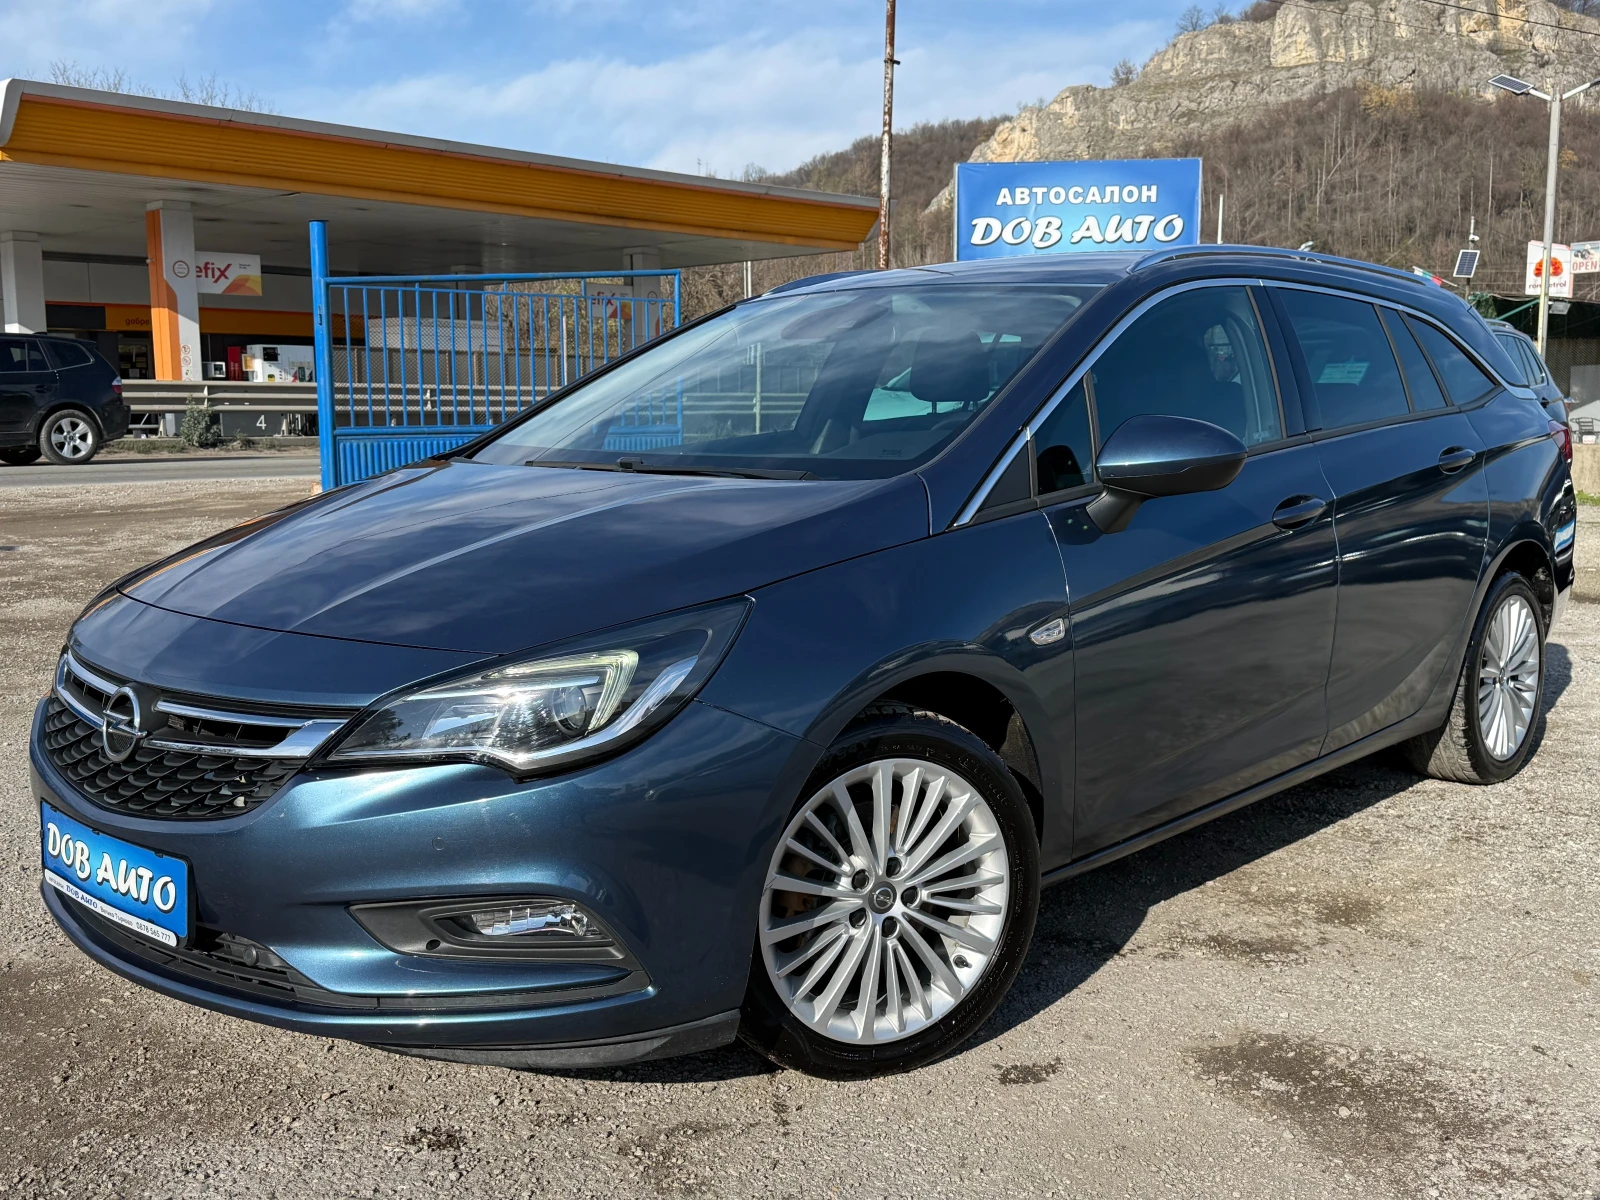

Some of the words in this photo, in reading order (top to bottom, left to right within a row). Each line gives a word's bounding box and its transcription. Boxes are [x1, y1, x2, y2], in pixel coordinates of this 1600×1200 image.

[995, 184, 1158, 206] АВТОСАЛОН
[970, 216, 1063, 249] DOB
[1070, 213, 1185, 245] AUTO
[1572, 260, 1598, 271] OPEN
[255, 414, 267, 430] 4
[47, 822, 92, 881] DOB
[96, 852, 176, 913] AUTO
[135, 922, 150, 934] 0878
[161, 932, 171, 942] 777
